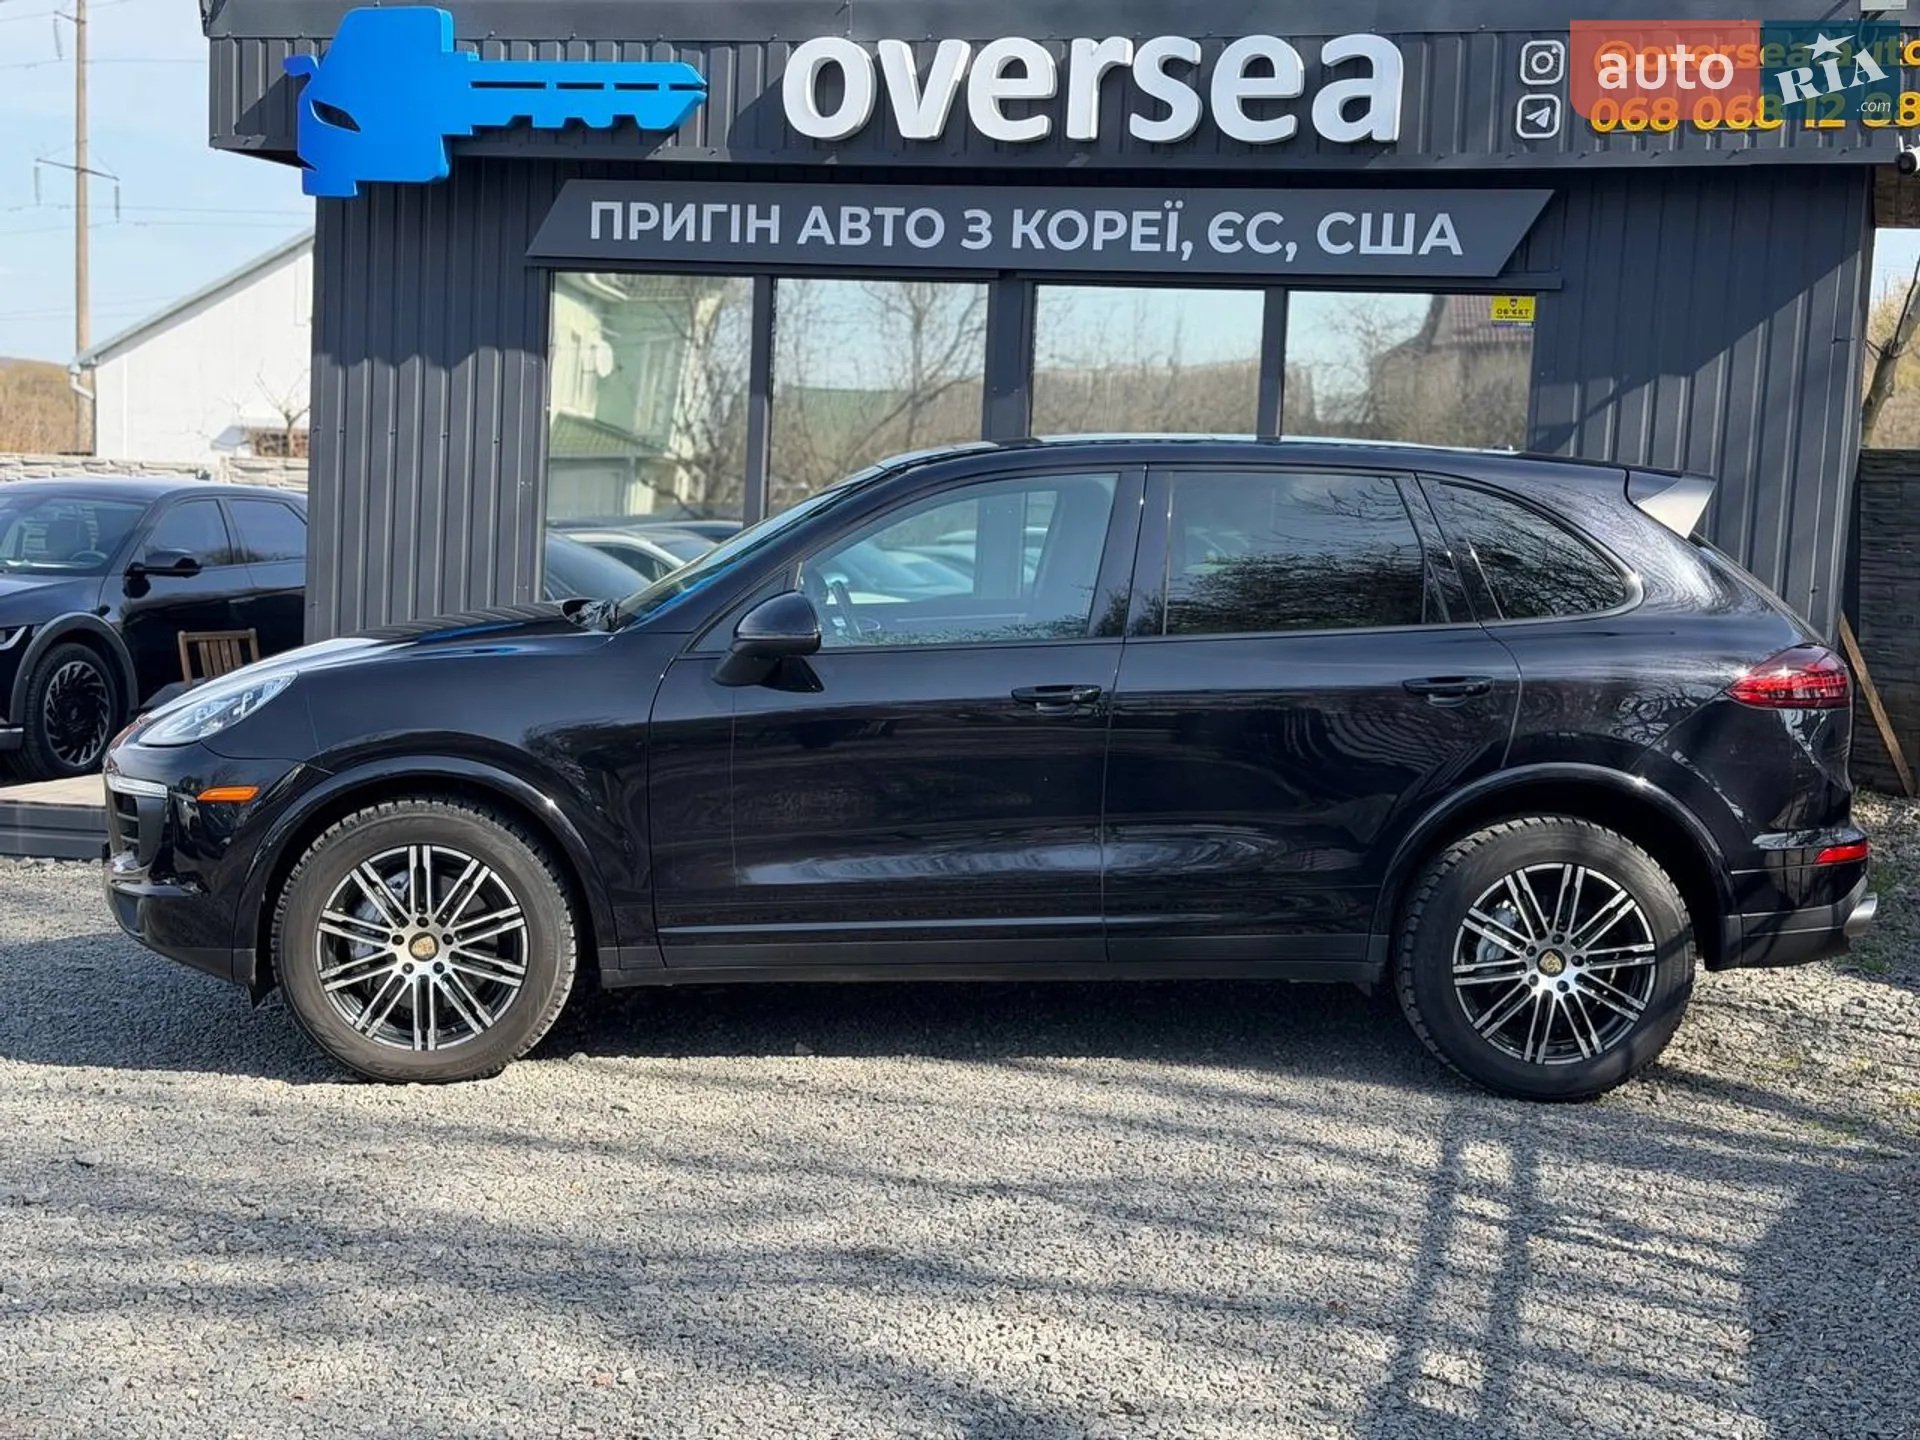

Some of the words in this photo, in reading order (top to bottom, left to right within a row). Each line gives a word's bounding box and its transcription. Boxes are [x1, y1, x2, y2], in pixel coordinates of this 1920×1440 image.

[783, 34, 1403, 143] oversea
[1590, 97, 1678, 132] 068
[1693, 93, 1784, 131] 068
[1804, 93, 1846, 128] 12
[590, 201, 780, 243] ПРИГІН
[797, 205, 946, 249] АВТО
[960, 208, 993, 250] З
[1012, 200, 1193, 262] КОРЕЇ,
[1207, 211, 1297, 262] ЄС,
[1316, 212, 1463, 256] США
